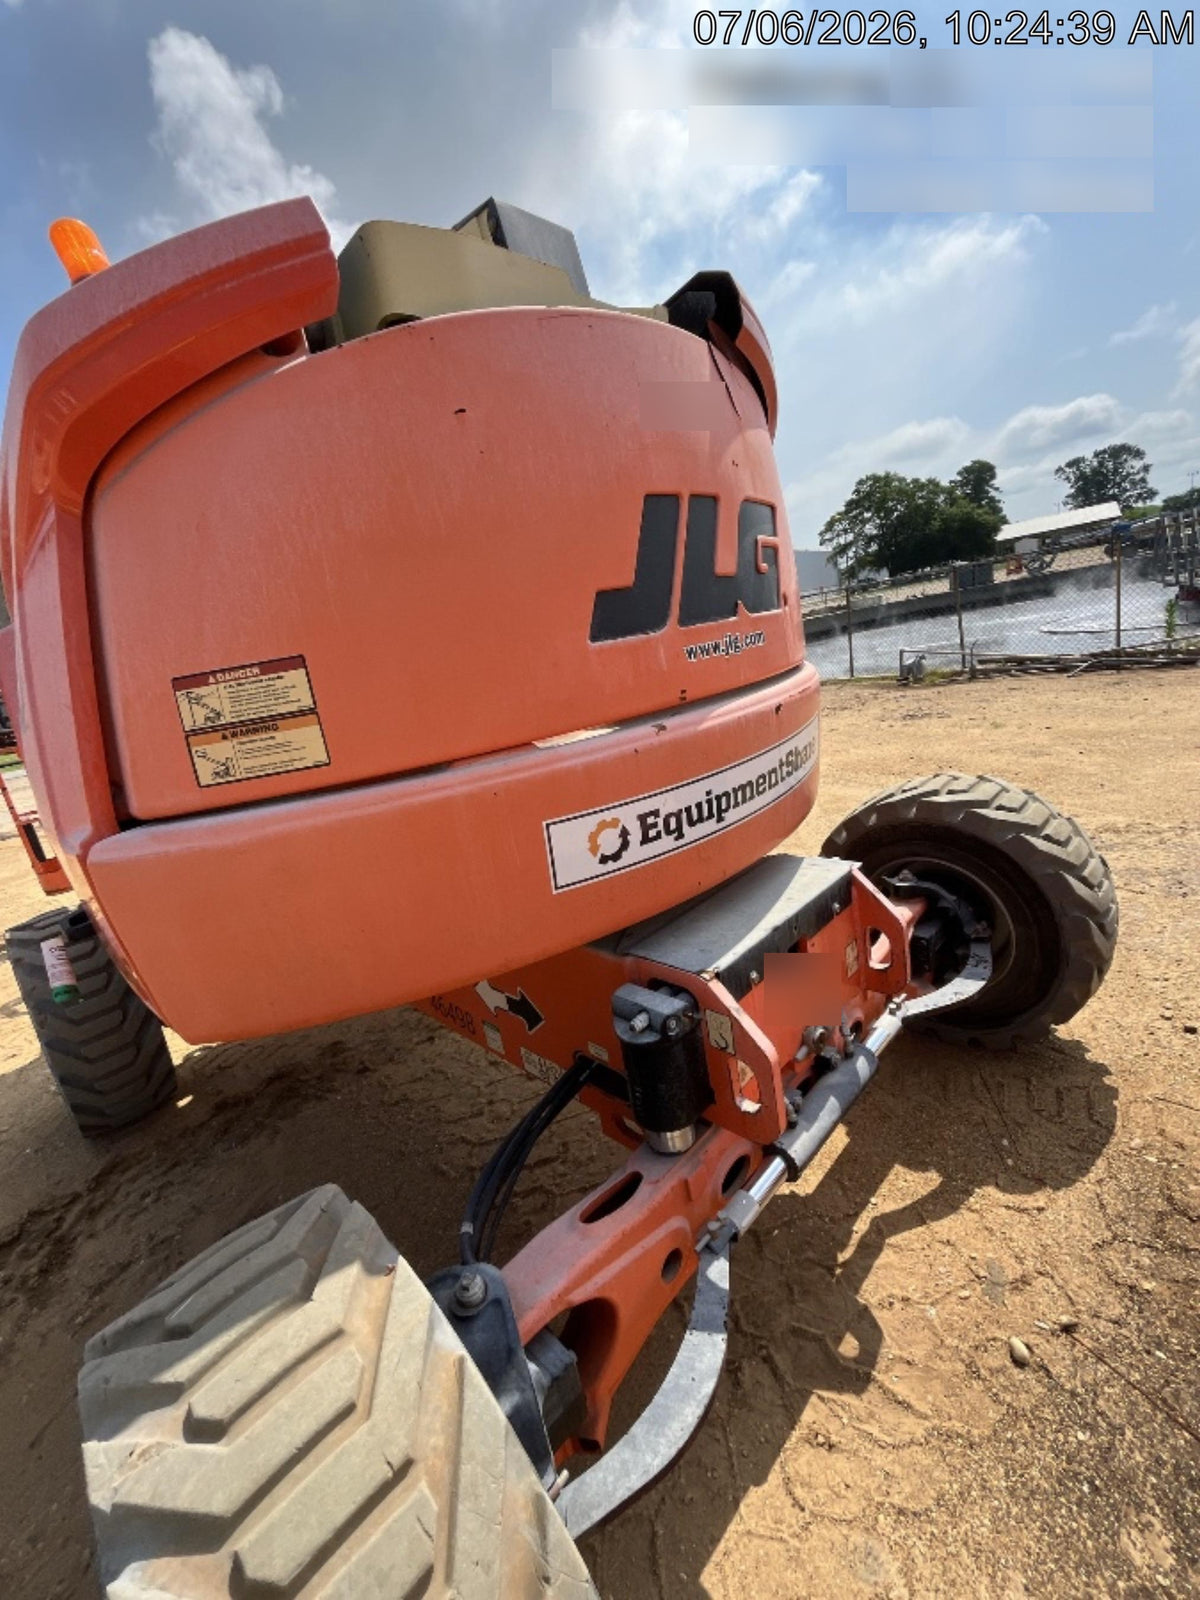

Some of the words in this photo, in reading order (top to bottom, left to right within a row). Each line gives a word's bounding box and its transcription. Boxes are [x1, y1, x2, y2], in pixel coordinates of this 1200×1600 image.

[589, 494, 780, 643] JLG
[684, 630, 765, 662] www.jlg.com
[216, 667, 261, 682] DANGER
[229, 723, 280, 740] WARNING
